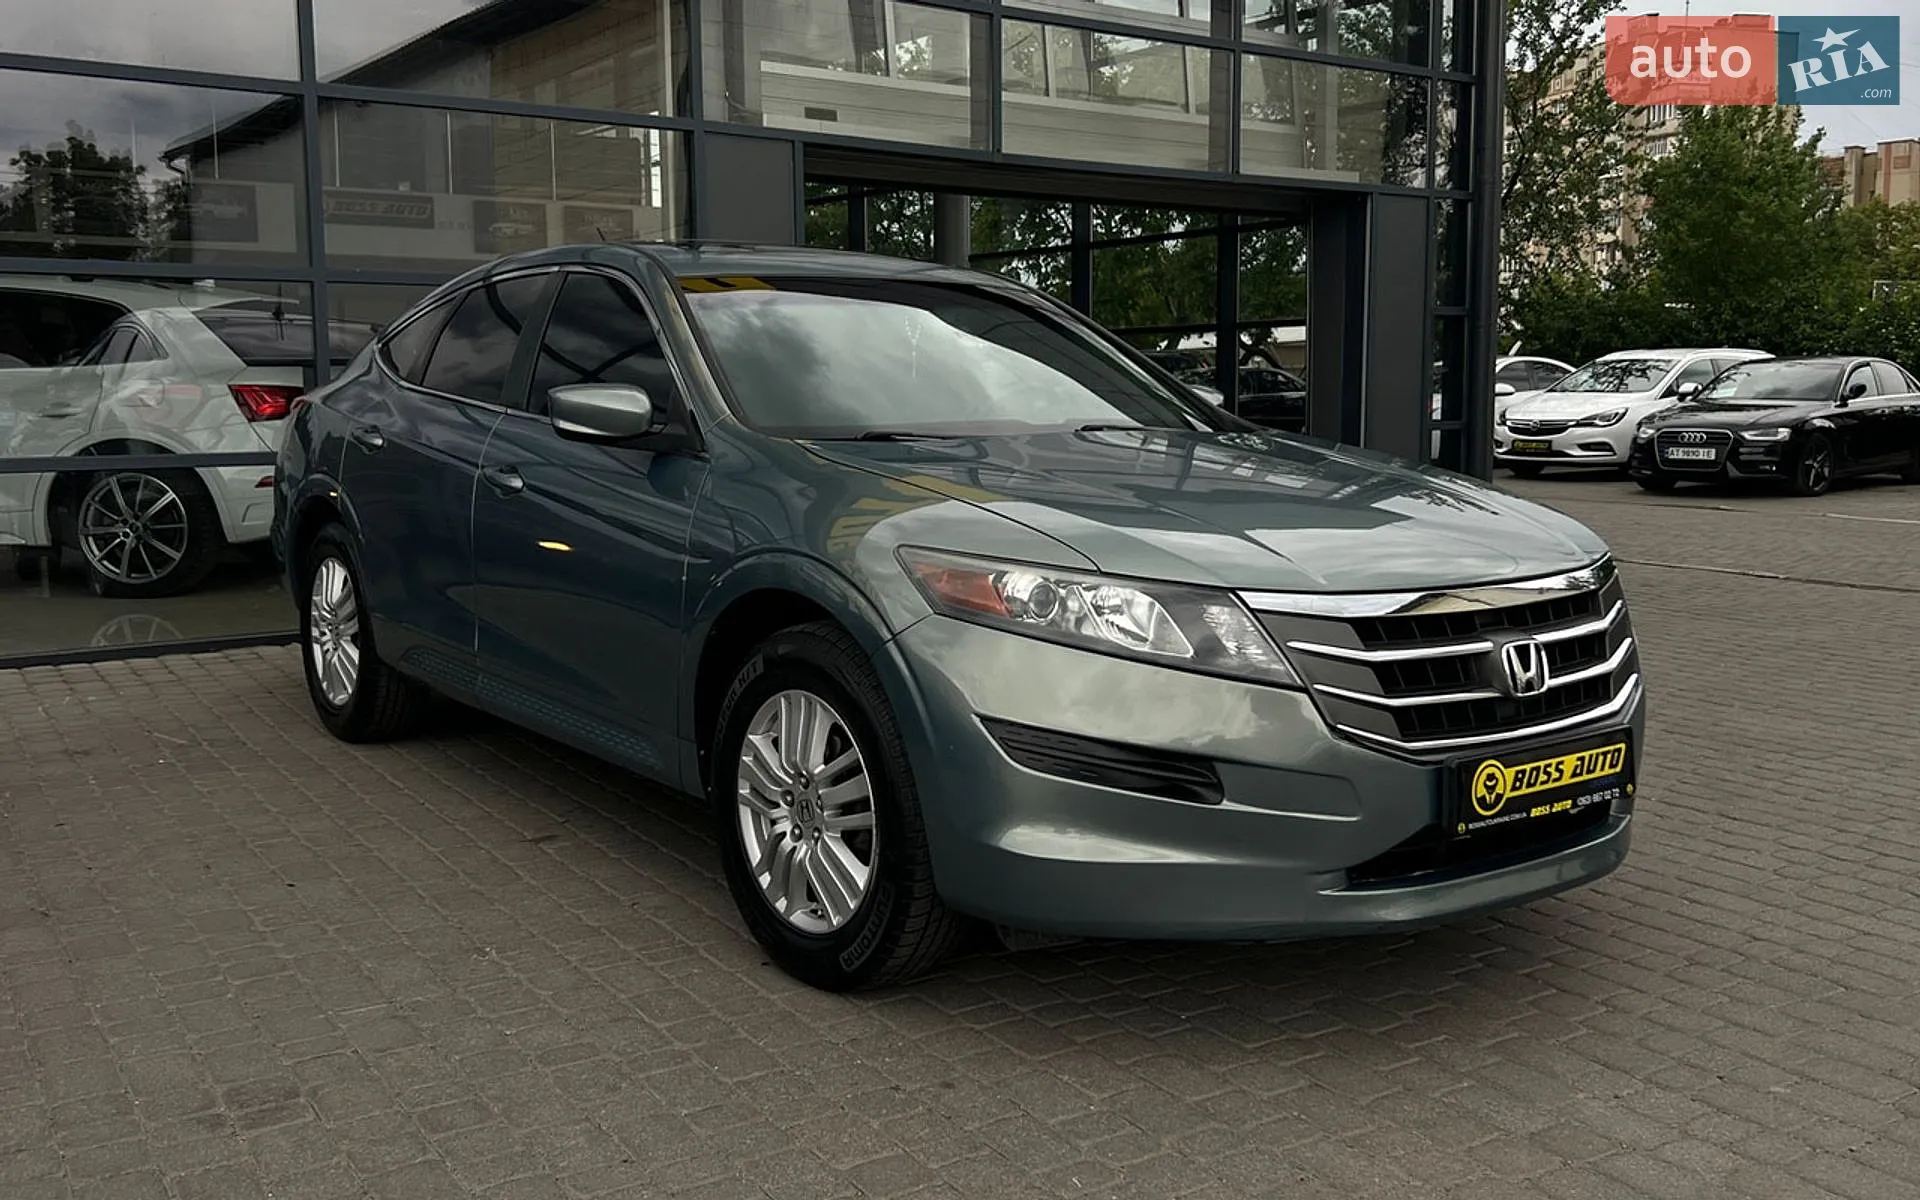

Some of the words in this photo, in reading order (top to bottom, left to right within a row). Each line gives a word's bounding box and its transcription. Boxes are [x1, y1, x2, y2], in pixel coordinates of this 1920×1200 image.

[382, 203, 428, 216] AUTO
[1510, 760, 1564, 793] BOSS
[1570, 748, 1622, 779] AUTO
[1530, 804, 1550, 818] BOSS
[1552, 799, 1573, 813] AUTO
